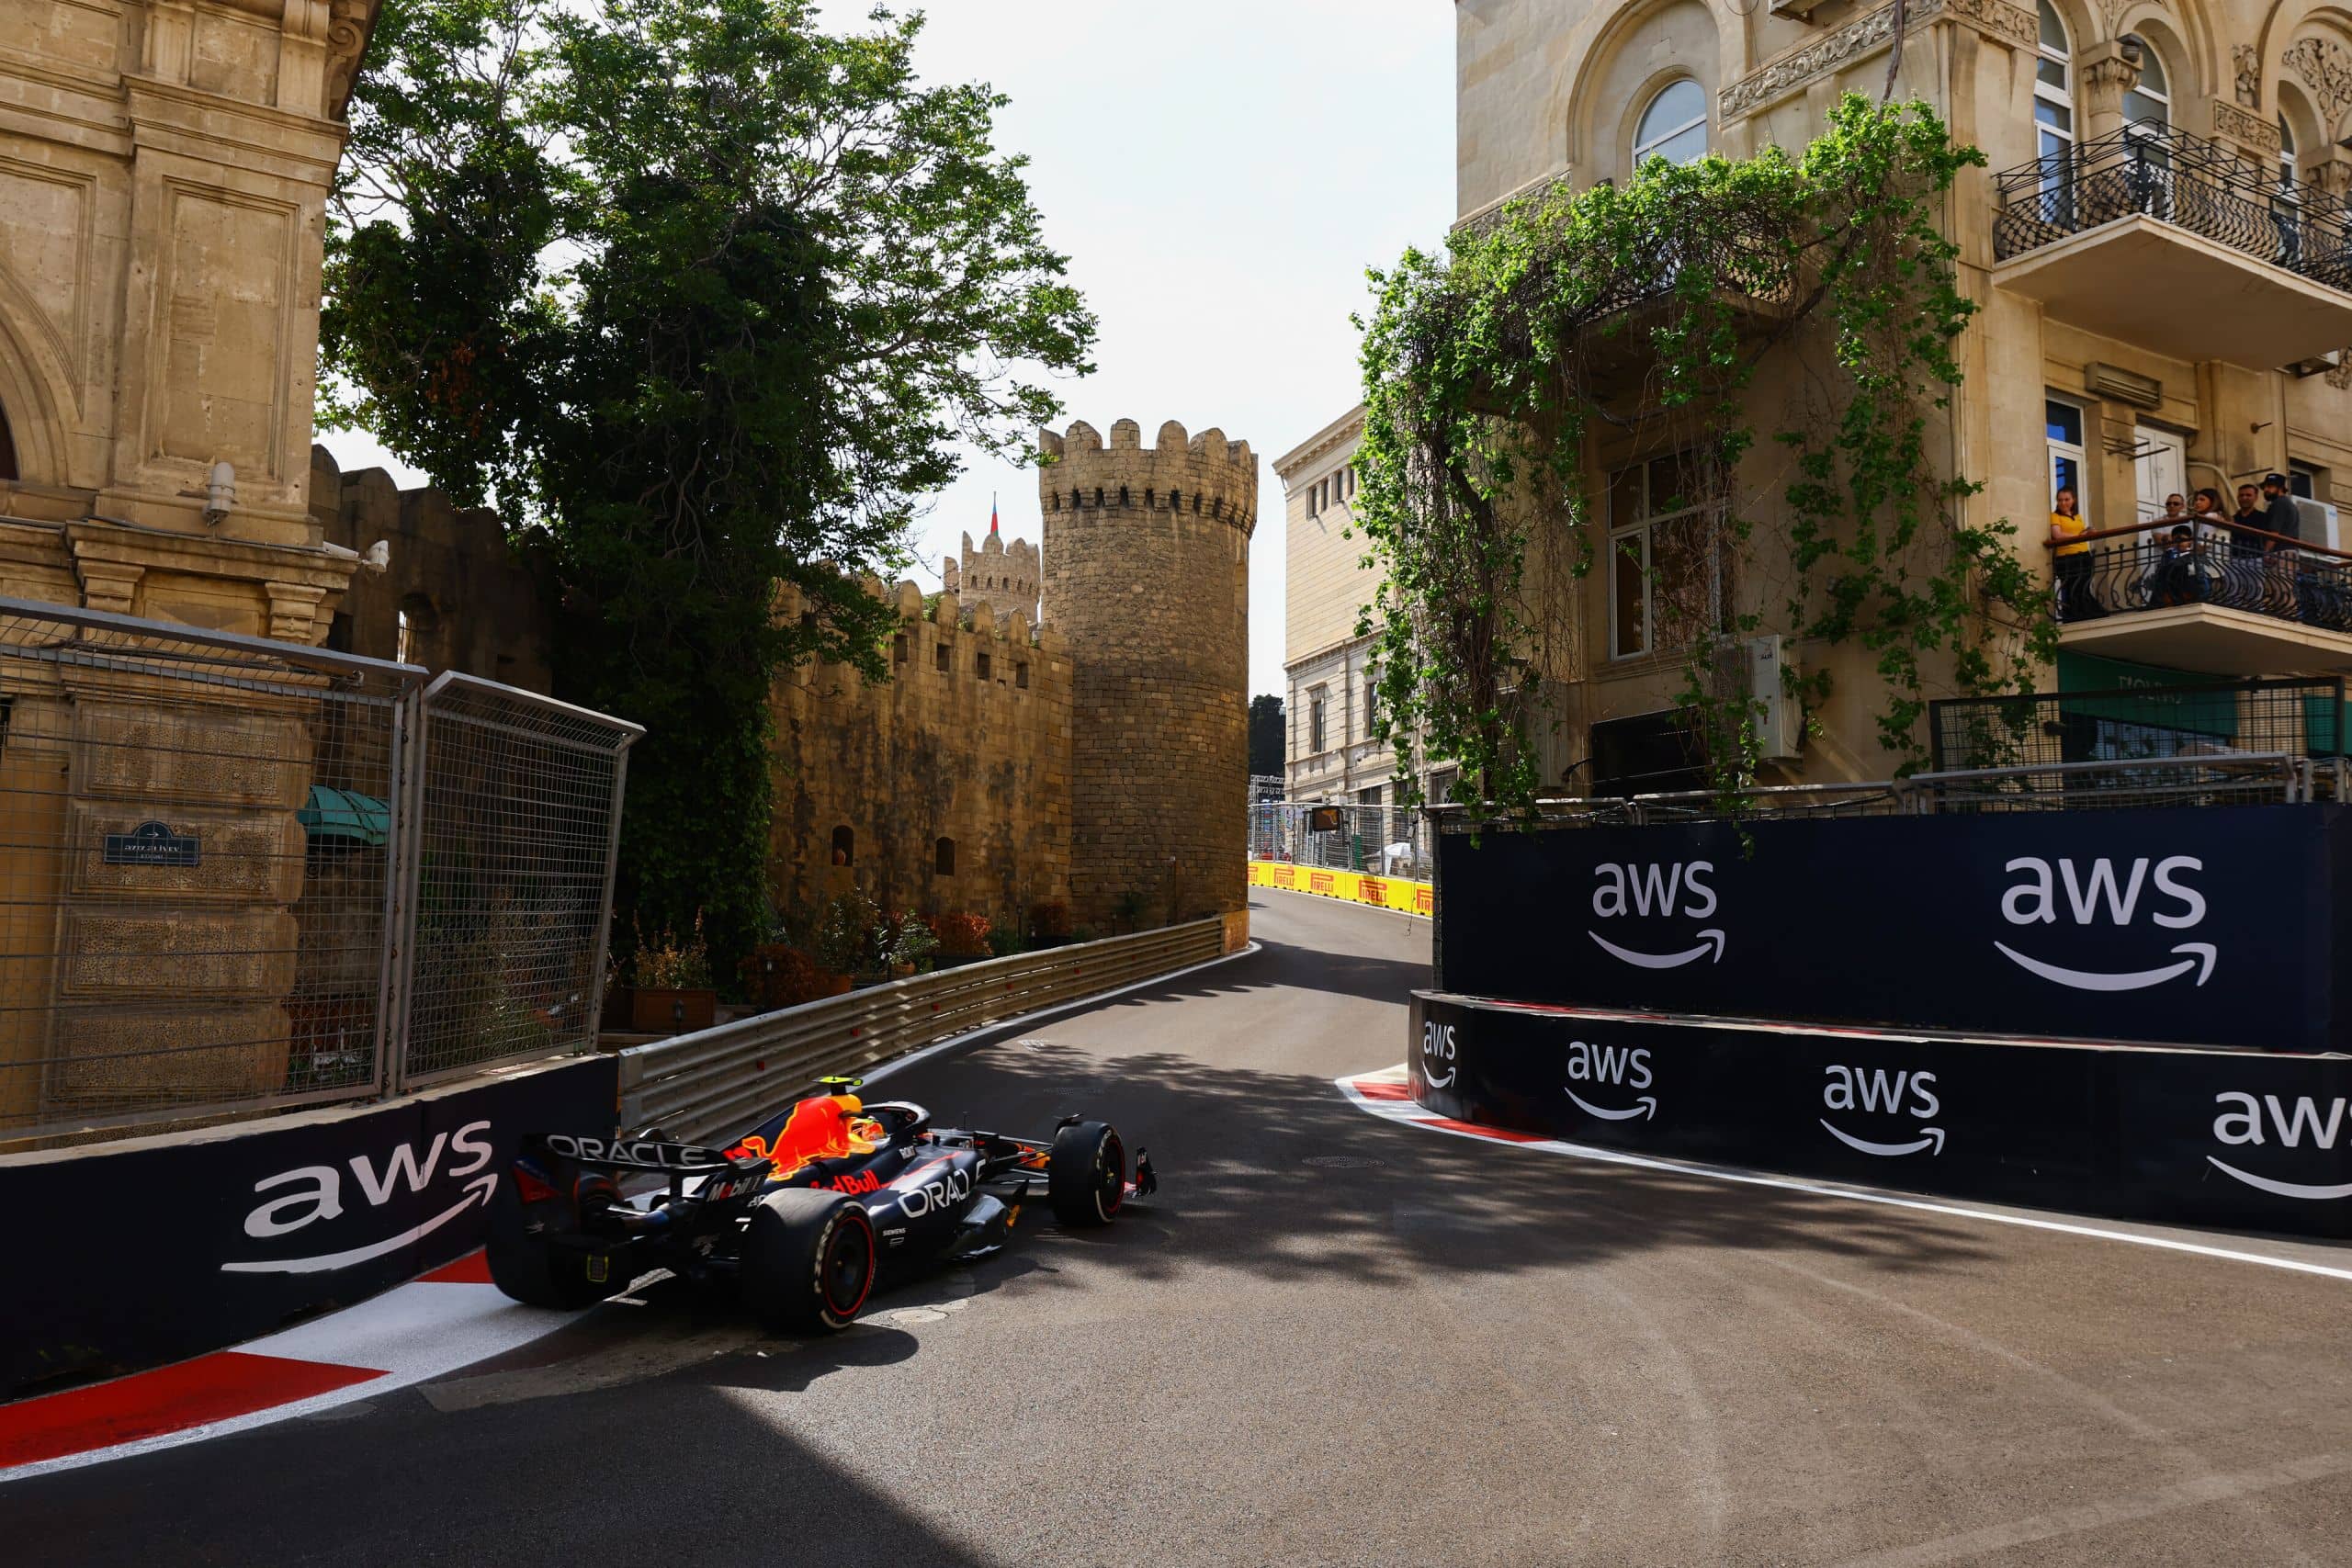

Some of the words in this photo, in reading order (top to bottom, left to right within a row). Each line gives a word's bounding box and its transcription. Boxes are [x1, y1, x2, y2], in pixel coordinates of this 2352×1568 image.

[1274, 868, 1295, 886] PIRELLI
[1310, 873, 1334, 892] PIRELLI
[1359, 879, 1387, 902] PIRELLI
[1592, 861, 1717, 919] aws
[2001, 855, 2206, 929] aws
[1424, 1021, 1455, 1060] aws
[1567, 1041, 1653, 1089] aws
[1824, 1065, 1939, 1119] aws
[2213, 1091, 2352, 1149] aw
[547, 1134, 707, 1168] ORACLE
[243, 1120, 492, 1237] aws
[841, 1169, 881, 1196] Bull
